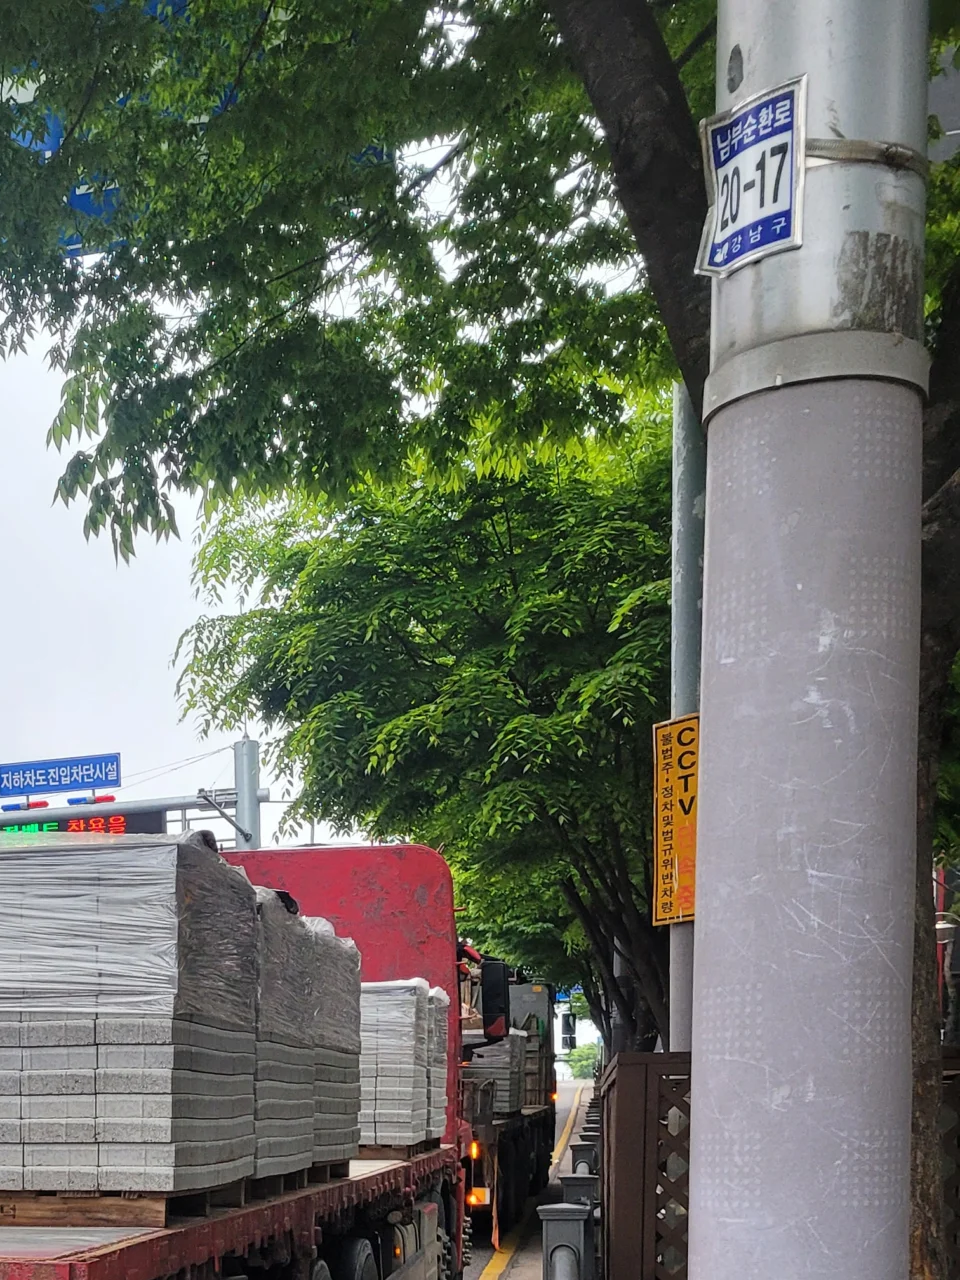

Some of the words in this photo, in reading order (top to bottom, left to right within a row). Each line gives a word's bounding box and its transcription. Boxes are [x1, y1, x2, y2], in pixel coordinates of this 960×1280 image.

[716, 98, 792, 162] 남부순환로
[719, 141, 789, 233] 20-17
[730, 216, 787, 254] 강남구
[0, 761, 118, 790] 지하차도진입차단시설
[676, 726, 696, 816] CCTV
